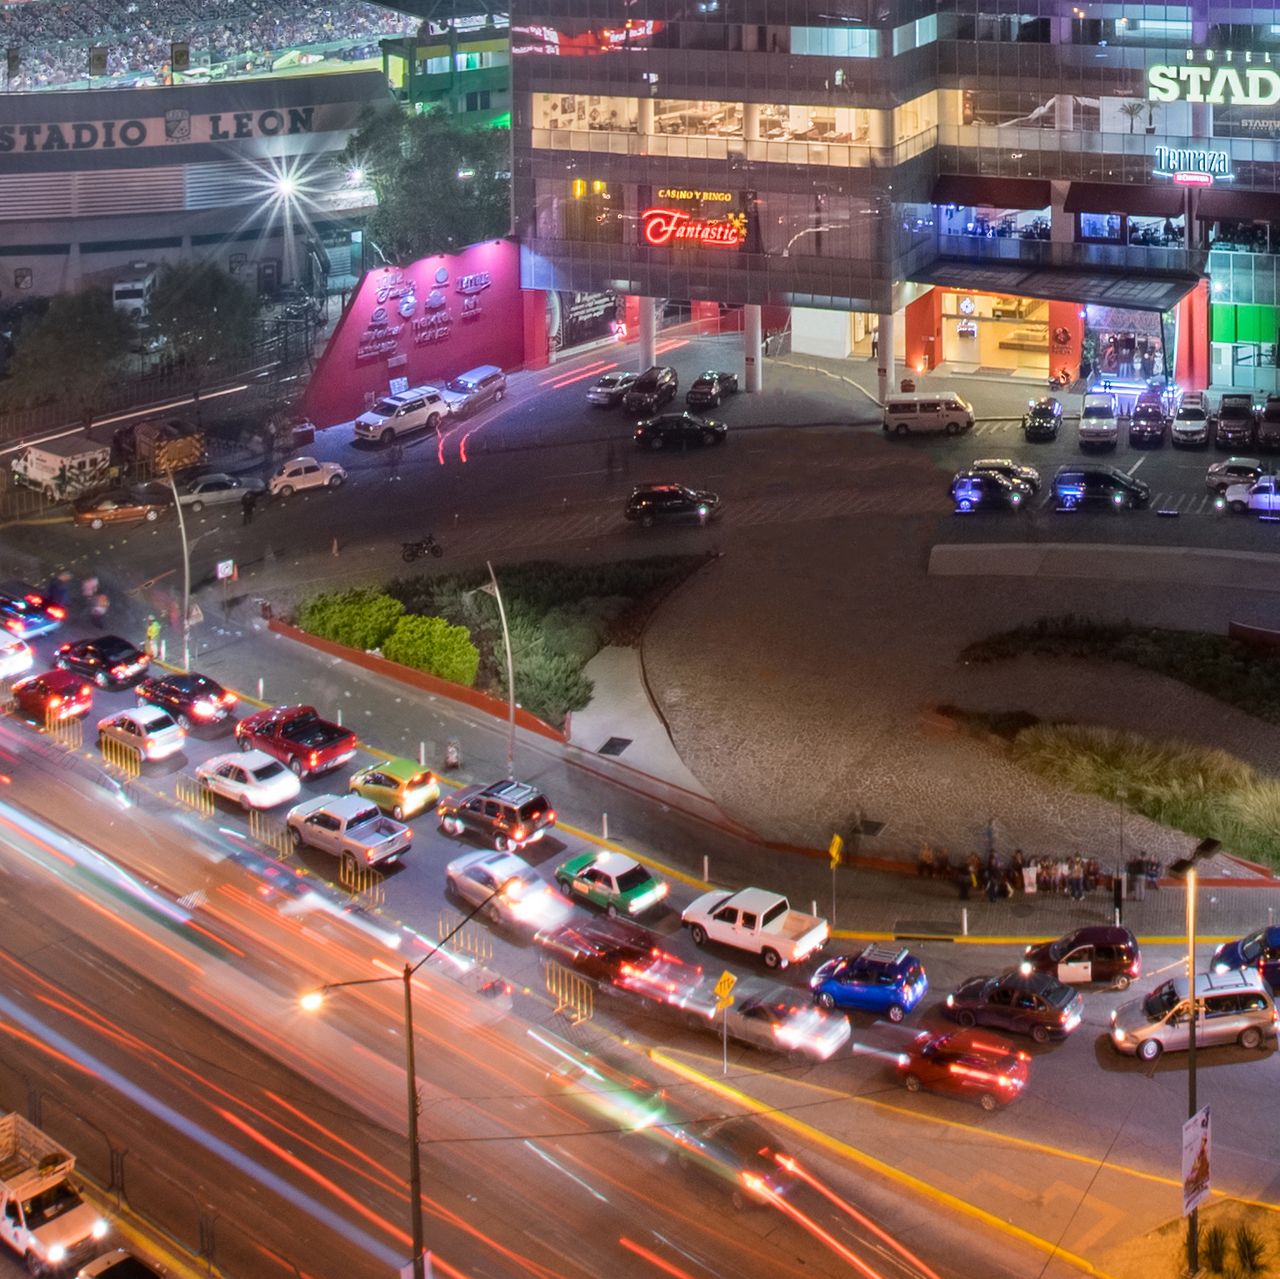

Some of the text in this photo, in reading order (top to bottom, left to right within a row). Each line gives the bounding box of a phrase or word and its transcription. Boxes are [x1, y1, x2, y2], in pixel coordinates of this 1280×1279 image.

[1186, 49, 1271, 63] HOTEL
[209, 107, 315, 141] LEON
[1154, 145, 1231, 173] Terraza
[658, 189, 694, 200] CASINO
[702, 191, 732, 202] BINGO
[641, 208, 738, 245] Fantastic
